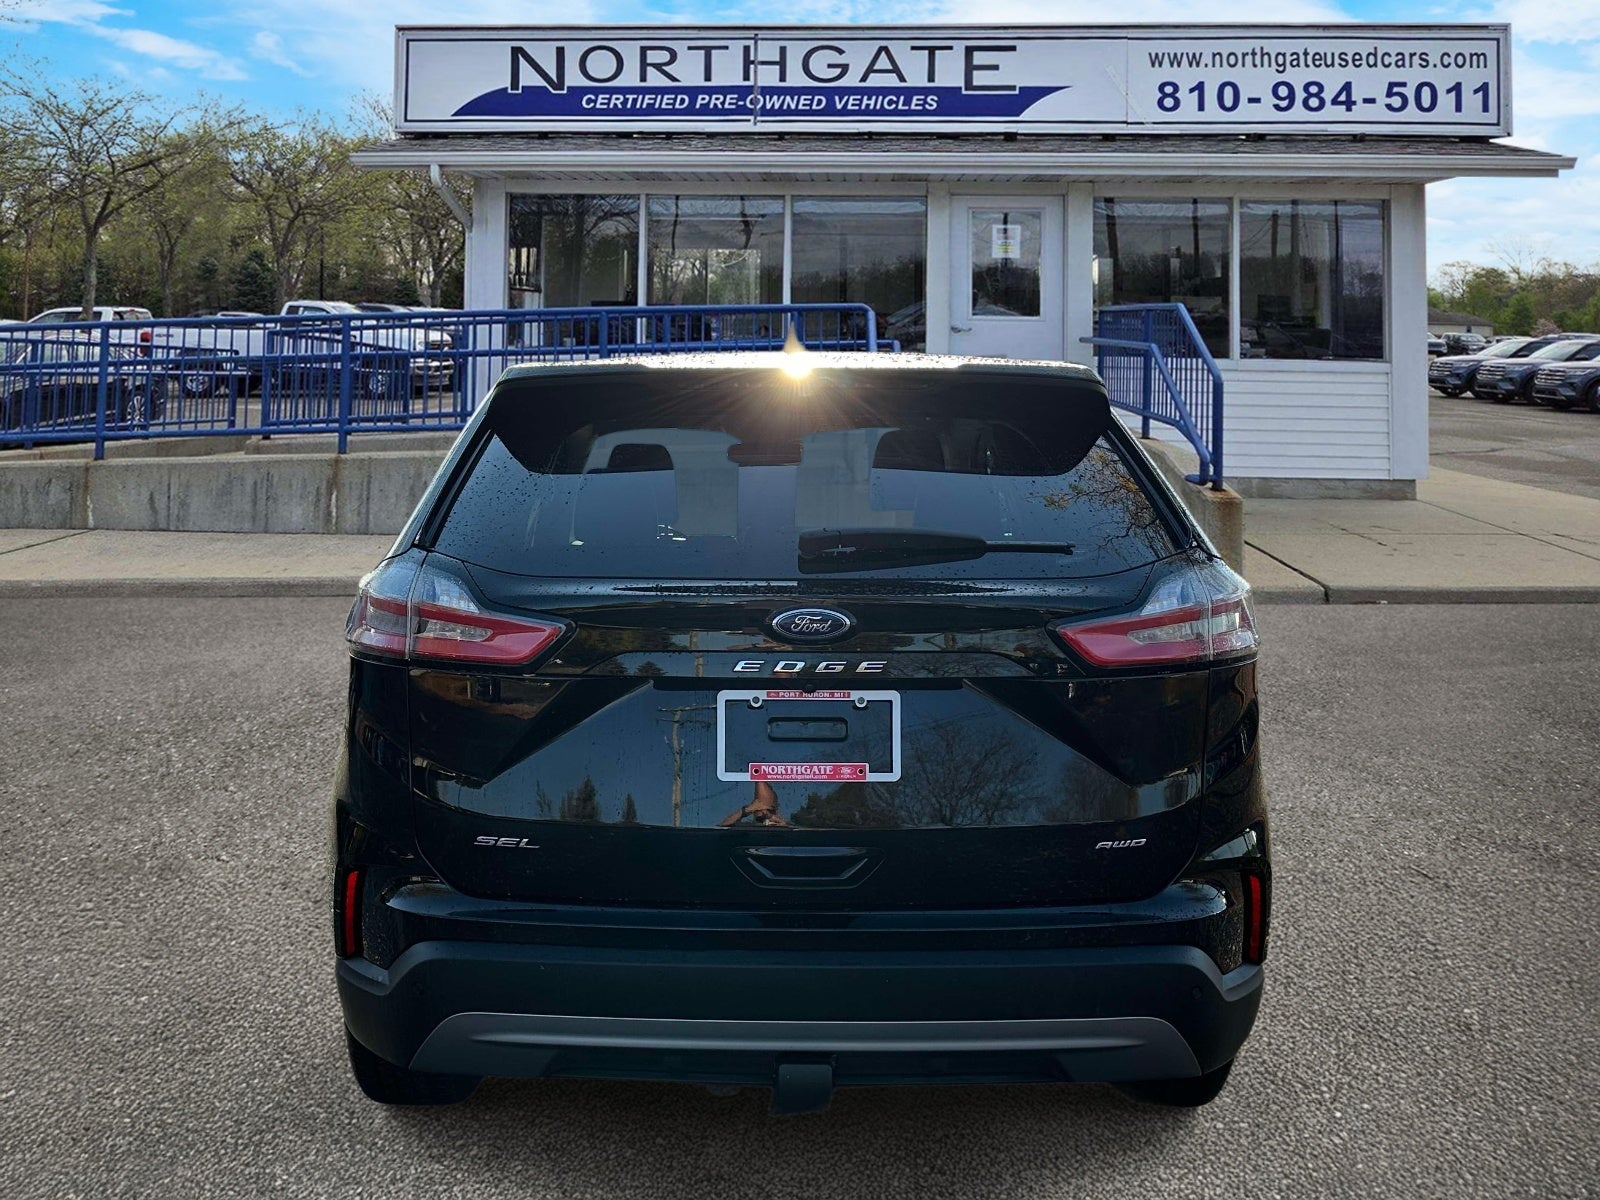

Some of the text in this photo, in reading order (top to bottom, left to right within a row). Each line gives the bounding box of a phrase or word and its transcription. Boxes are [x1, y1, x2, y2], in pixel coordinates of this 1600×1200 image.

[510, 45, 1017, 92] NORTHGATE
[1148, 46, 1489, 74] www.northgateusedcars.com
[581, 93, 938, 110] CERTIFIED PRE-OWNED VEHICLES
[1156, 80, 1491, 113] 810-984-5011
[791, 615, 832, 633] Ford
[733, 660, 888, 673] EDGE
[760, 765, 834, 775] NORTHGATE
[473, 835, 540, 849] SEL
[1095, 838, 1147, 850] AWD
